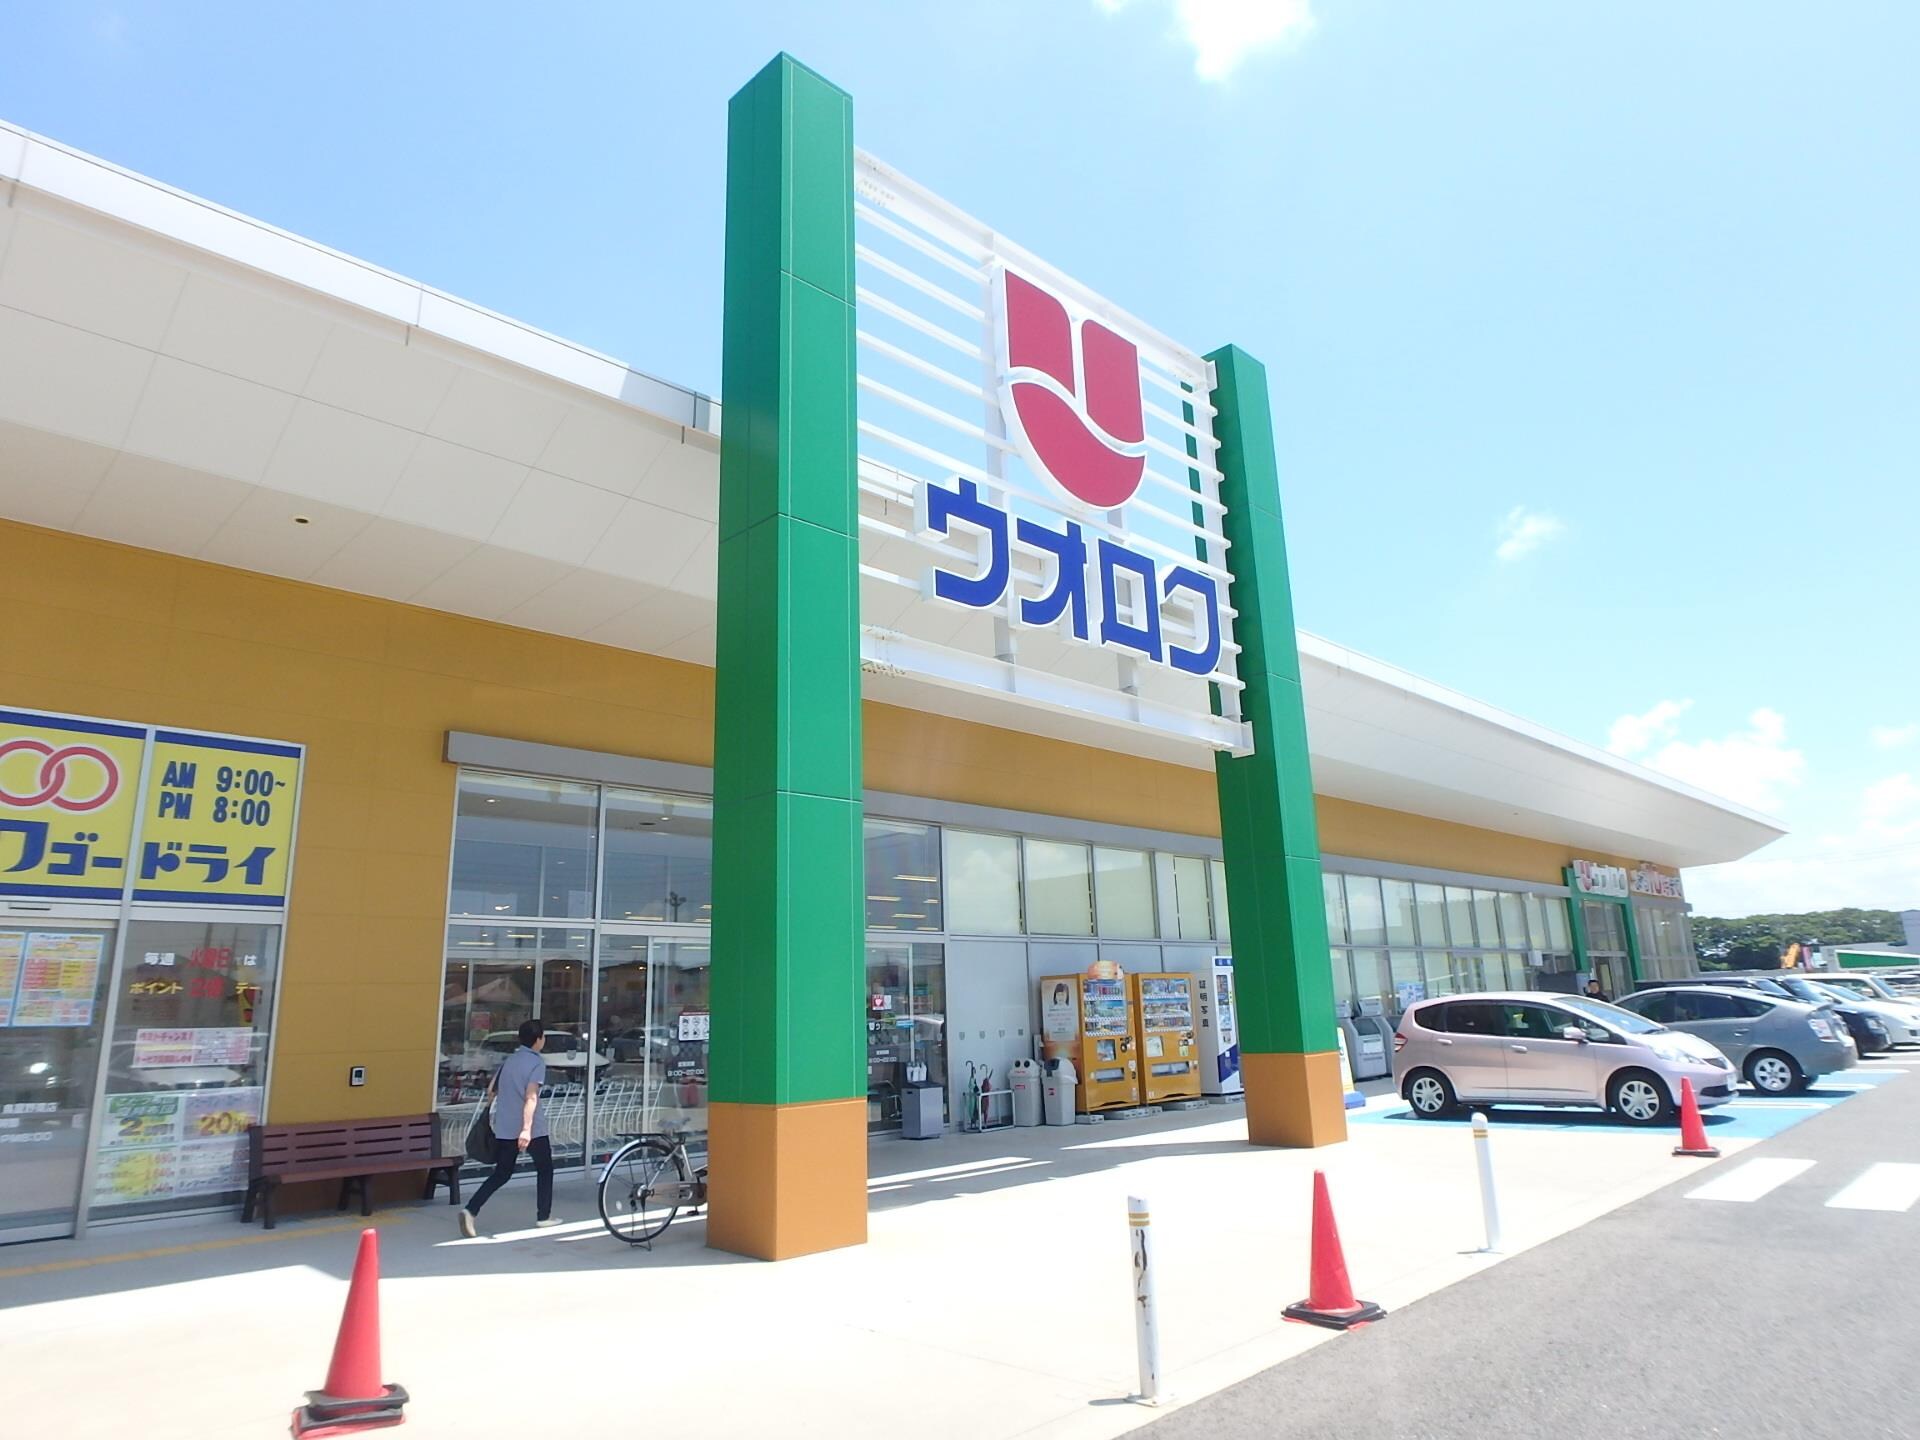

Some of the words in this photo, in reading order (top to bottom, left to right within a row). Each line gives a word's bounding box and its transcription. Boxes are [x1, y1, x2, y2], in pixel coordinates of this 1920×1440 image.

[925, 476, 1222, 676] ウオロク
[161, 760, 197, 789] AM
[215, 766, 286, 797] 9:00~
[158, 791, 193, 820] PM
[212, 796, 271, 826] 8:00
[144, 952, 175, 966] 毎週
[243, 954, 257, 966] は
[129, 982, 184, 994] ポイント
